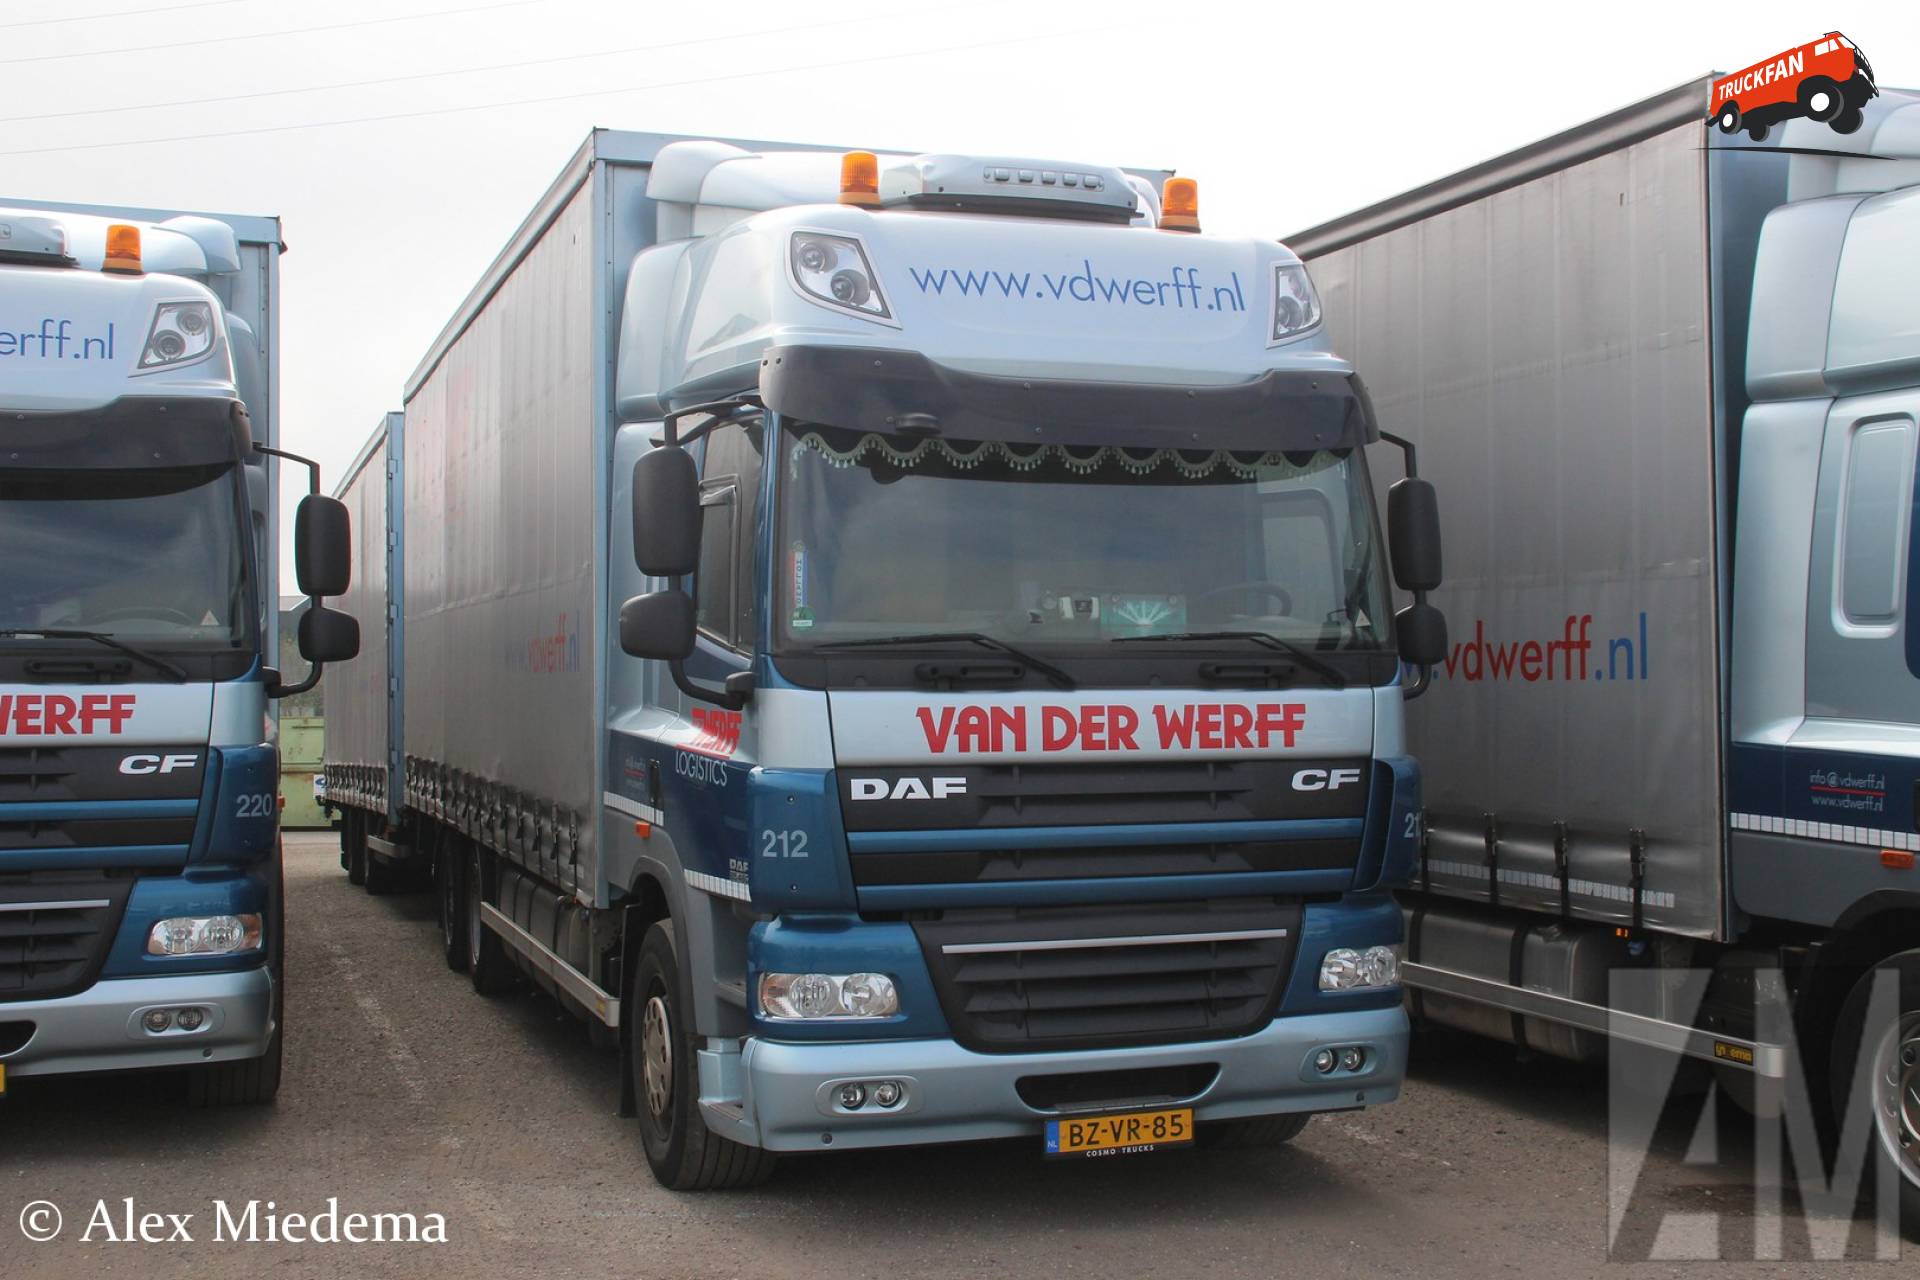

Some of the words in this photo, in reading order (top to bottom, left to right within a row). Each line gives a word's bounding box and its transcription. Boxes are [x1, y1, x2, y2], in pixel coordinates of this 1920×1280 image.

[909, 259, 1246, 312] www.vdwerff.nl
[916, 706, 1027, 753] VAN
[1041, 704, 1139, 751] DER
[1152, 702, 1306, 749] WERFF
[119, 754, 198, 775] CF
[675, 751, 728, 787] LOGISTICS
[850, 776, 967, 800] DAF
[1291, 768, 1361, 791] CF
[236, 793, 272, 818] 220
[762, 829, 808, 858] 212
[1047, 1141, 1058, 1149] NL
[1069, 1114, 1184, 1147] BZ-VR-85
[1086, 1148, 1116, 1158] COSMO
[1121, 1144, 1155, 1154] TRUCKS
